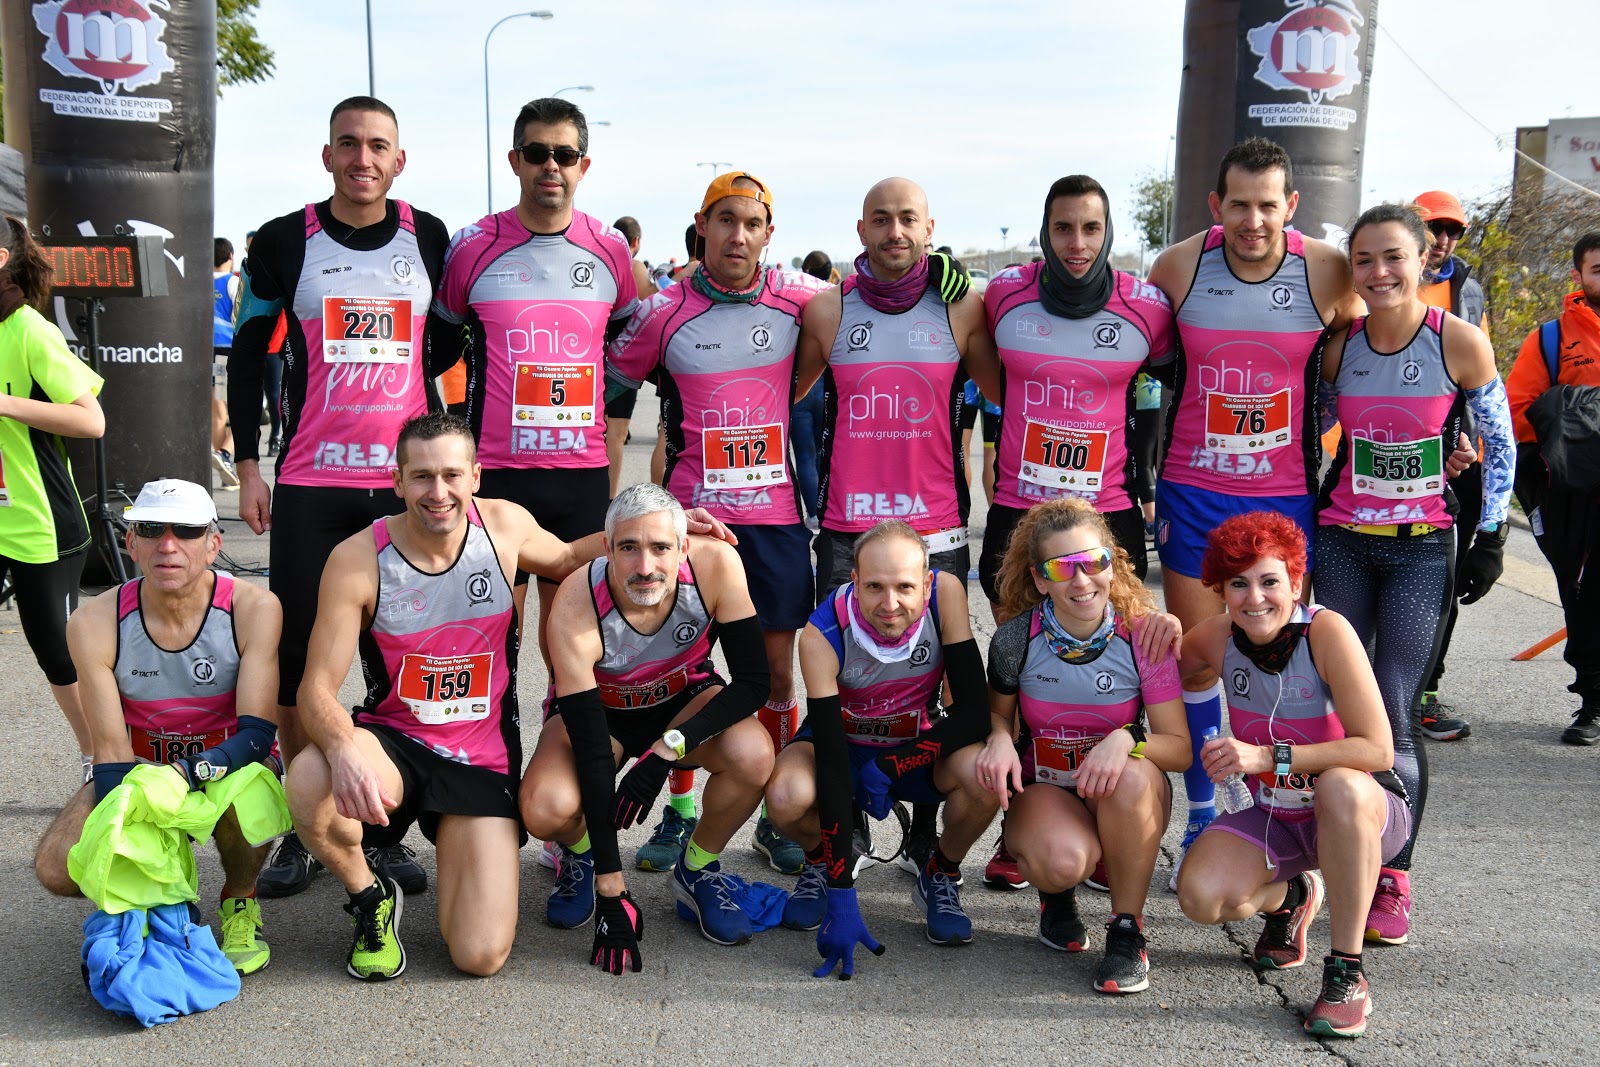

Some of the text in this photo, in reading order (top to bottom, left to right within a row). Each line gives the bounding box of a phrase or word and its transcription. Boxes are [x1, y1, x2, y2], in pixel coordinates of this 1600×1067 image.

[42, 91, 170, 110] FEDERACIÓN DE DEPORTES
[71, 104, 118, 117] MONTAÑA
[1251, 103, 1306, 114] FEDERACIÓN
[1323, 108, 1356, 119] DEPORTES
[1279, 114, 1320, 124] MONTAÑA
[1334, 119, 1347, 127] CLM
[343, 311, 393, 340] 220
[908, 328, 928, 345] phi
[1016, 320, 1037, 334] phi
[506, 321, 559, 363] phi
[550, 379, 566, 406] 5
[1024, 377, 1074, 414] phi
[330, 401, 403, 414] www.grupophi.es
[850, 386, 899, 429] phi
[1232, 409, 1266, 435] 76
[849, 428, 932, 441] www.grupophi.es
[723, 440, 767, 468] 112
[1041, 440, 1089, 470] 100
[1373, 454, 1422, 480] 558
[855, 492, 928, 516] REDA
[389, 599, 412, 618] phi
[422, 670, 472, 701] 159
[619, 684, 669, 708] 179
[149, 739, 205, 764] 180
